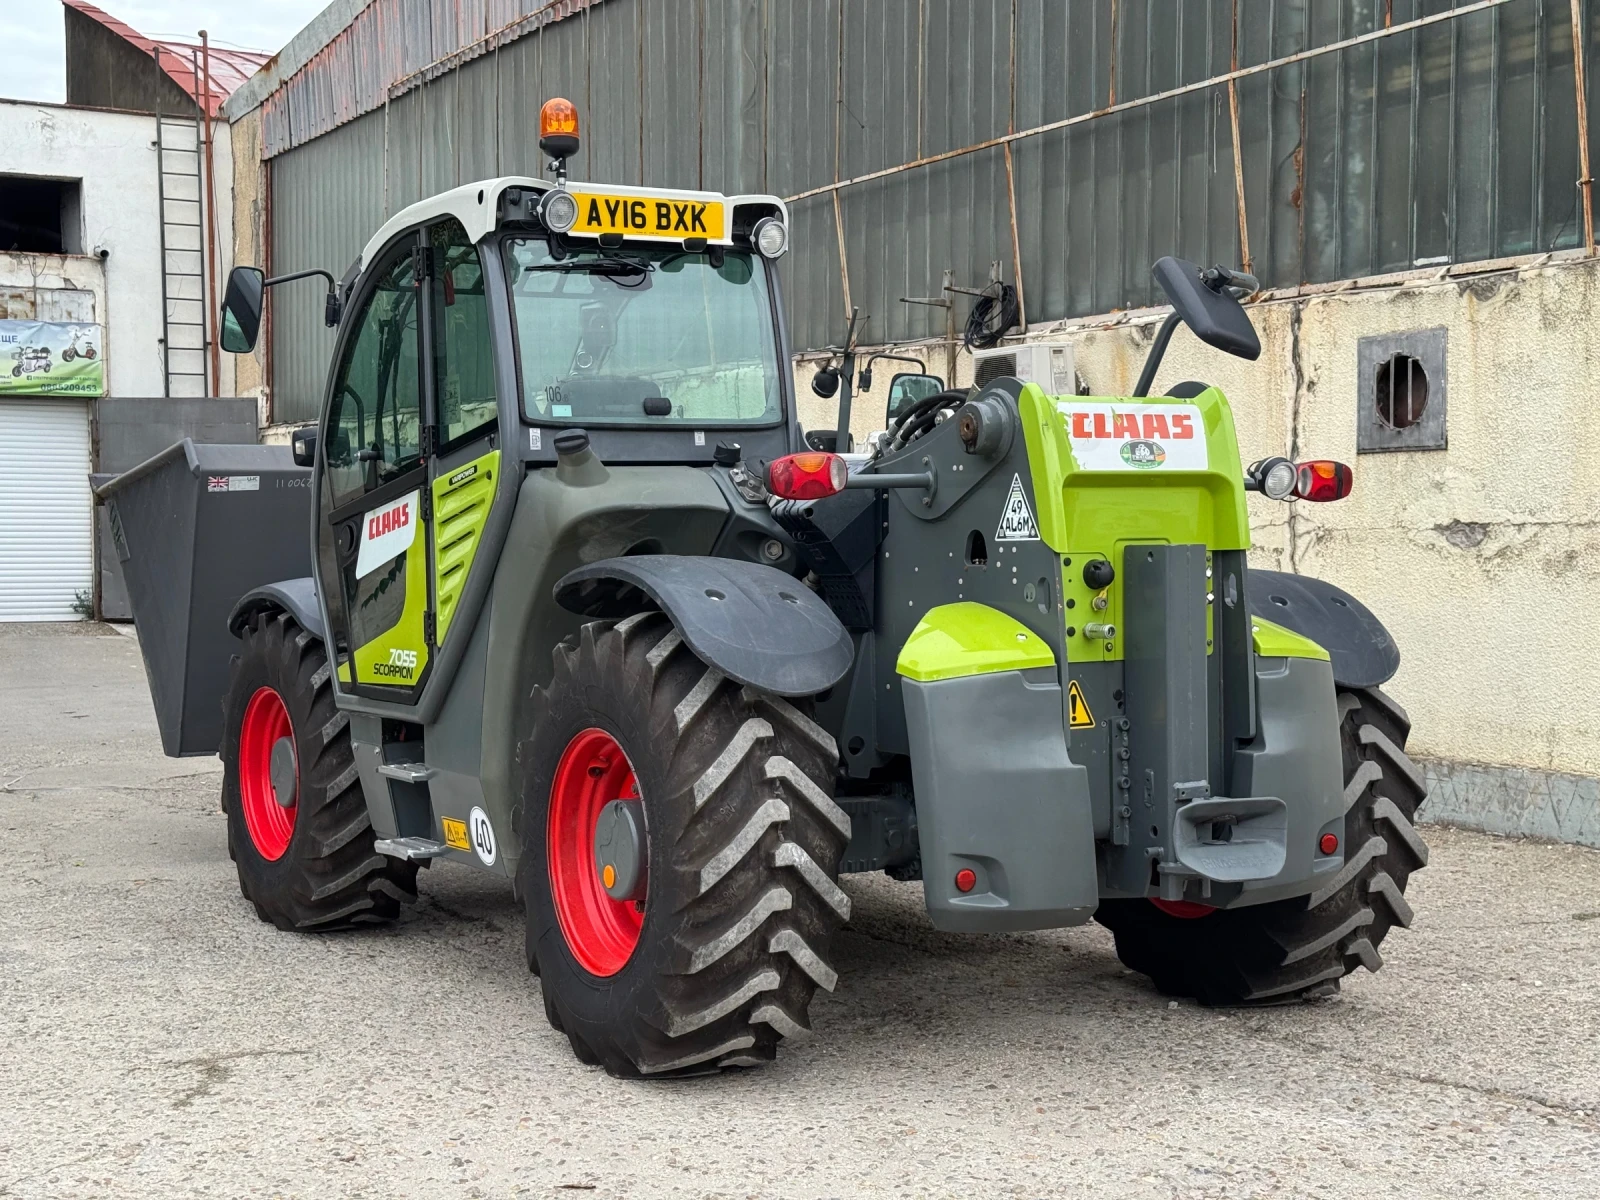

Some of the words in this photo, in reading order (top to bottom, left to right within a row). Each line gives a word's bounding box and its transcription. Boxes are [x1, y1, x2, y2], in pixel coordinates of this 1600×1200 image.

[586, 198, 647, 229] AY16
[655, 202, 707, 232] BXK
[0, 335, 20, 344] ЩЕ,
[545, 386, 561, 402] 106
[1072, 413, 1193, 439] CLAAS
[1011, 500, 1023, 515] 49
[369, 503, 409, 540] CLAAS
[1005, 517, 1030, 533] AL6M
[389, 648, 417, 667] 7055
[373, 663, 413, 679] SCORPION
[475, 818, 492, 855] 40
